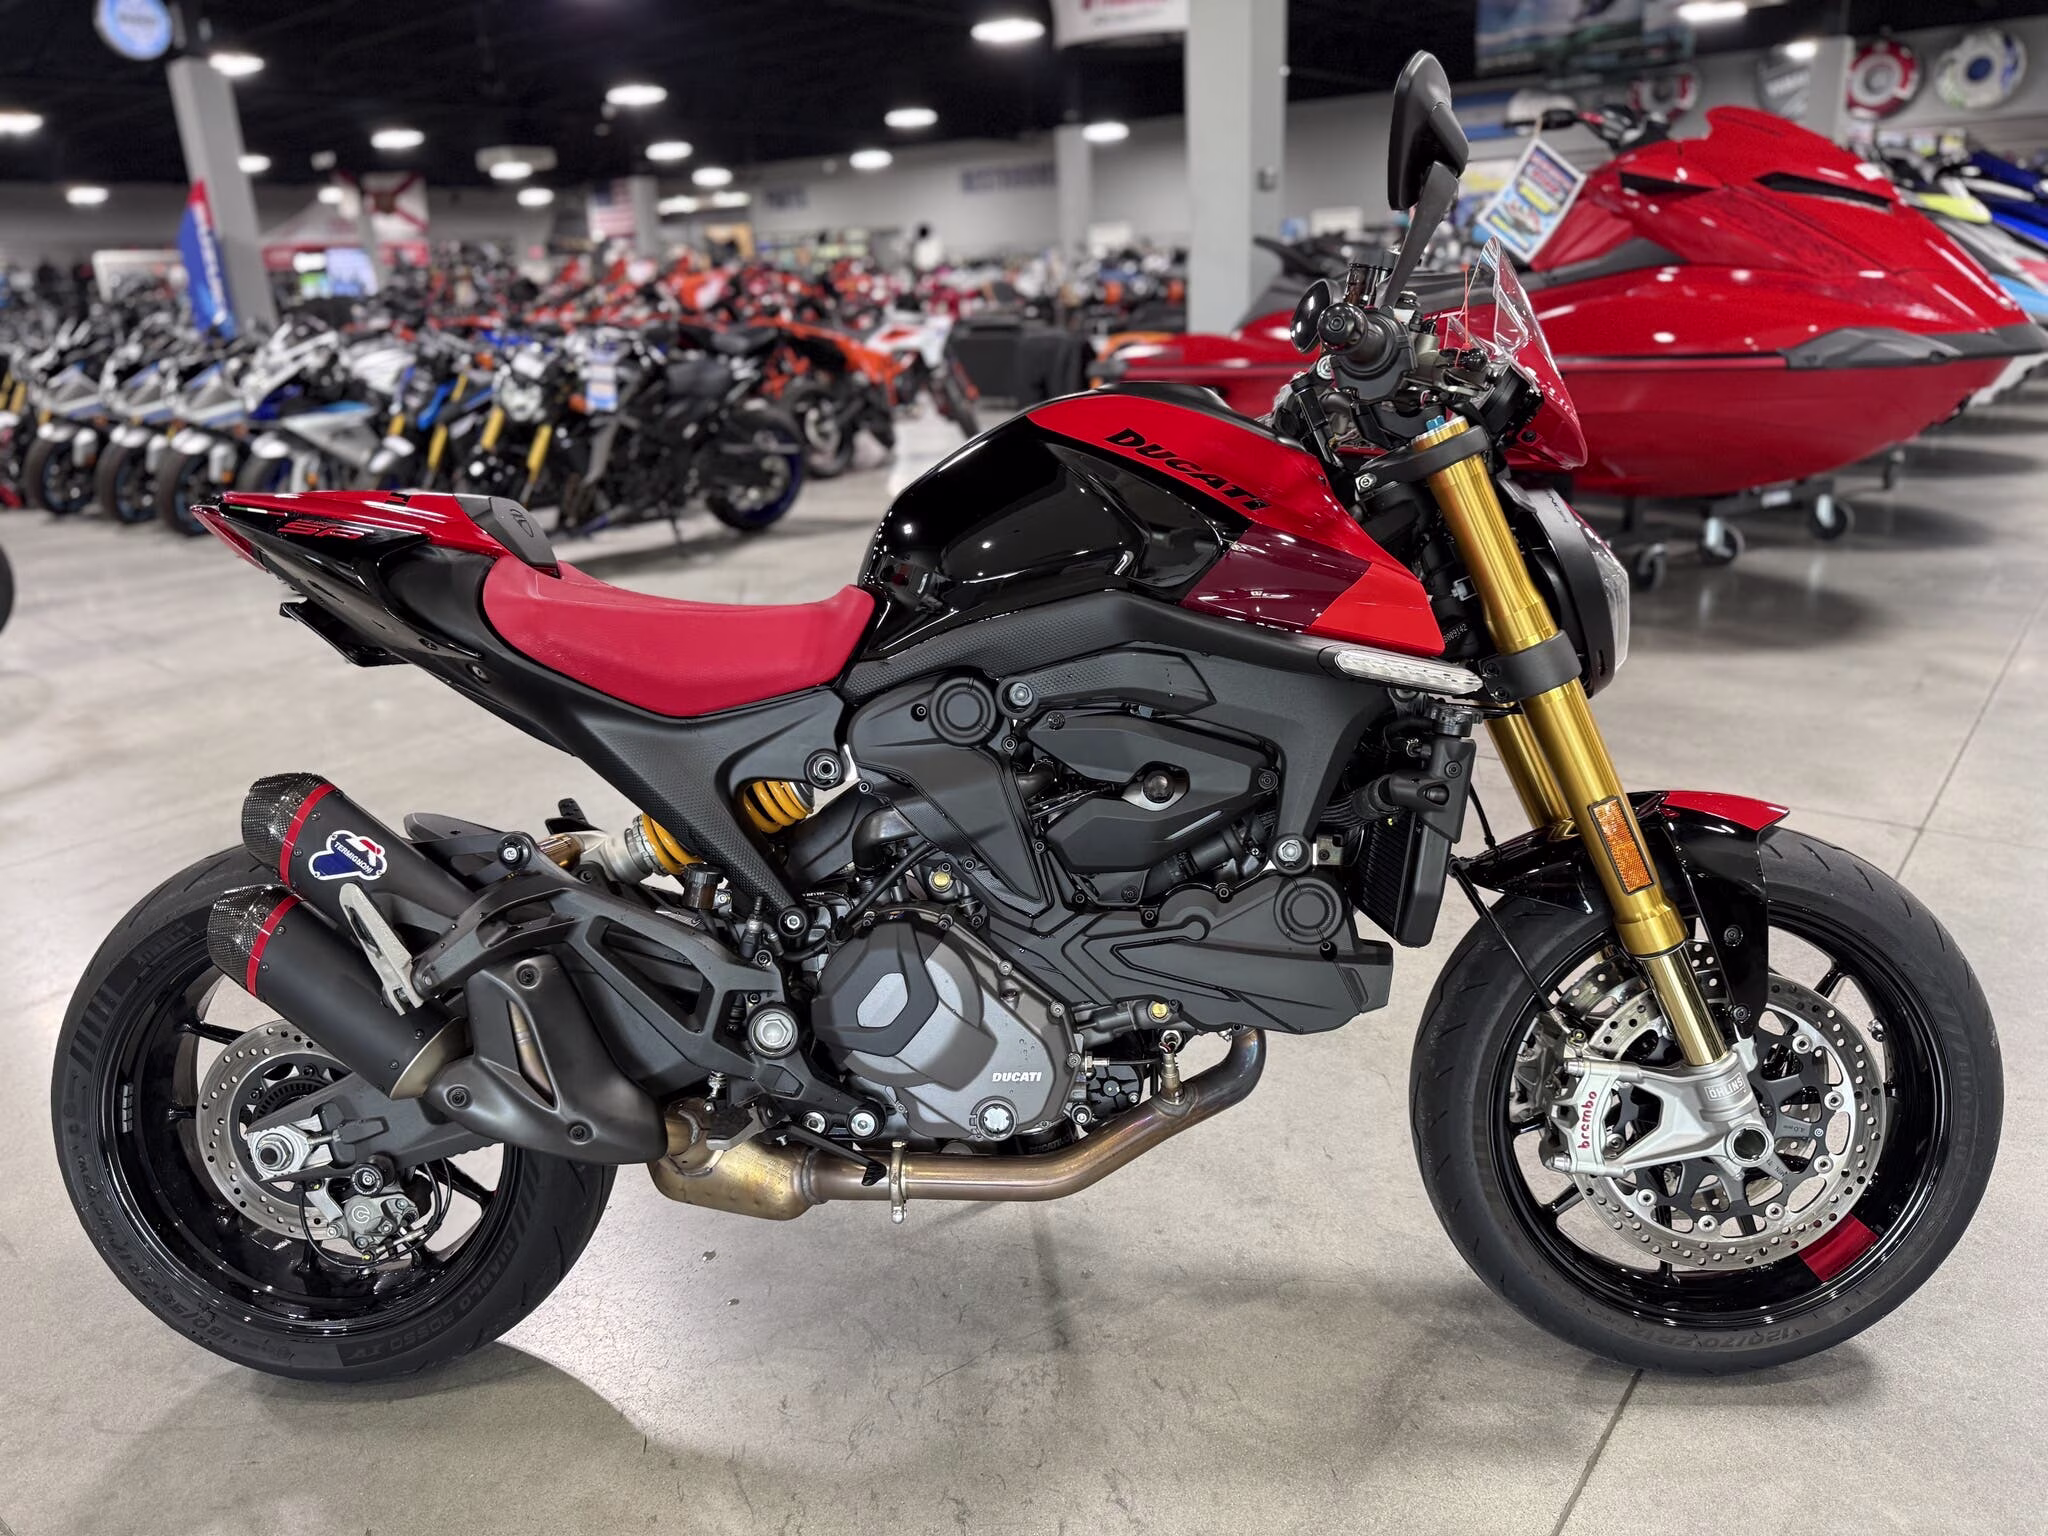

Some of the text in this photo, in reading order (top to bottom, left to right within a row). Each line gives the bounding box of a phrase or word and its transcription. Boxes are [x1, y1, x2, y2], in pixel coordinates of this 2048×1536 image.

[1104, 428, 1271, 511] DUCATI
[334, 841, 374, 874] TERMIGNONI
[992, 1071, 1042, 1082] DUCATI
[1708, 1076, 1743, 1098] ÖHLINS
[1577, 1091, 1597, 1149] brembo
